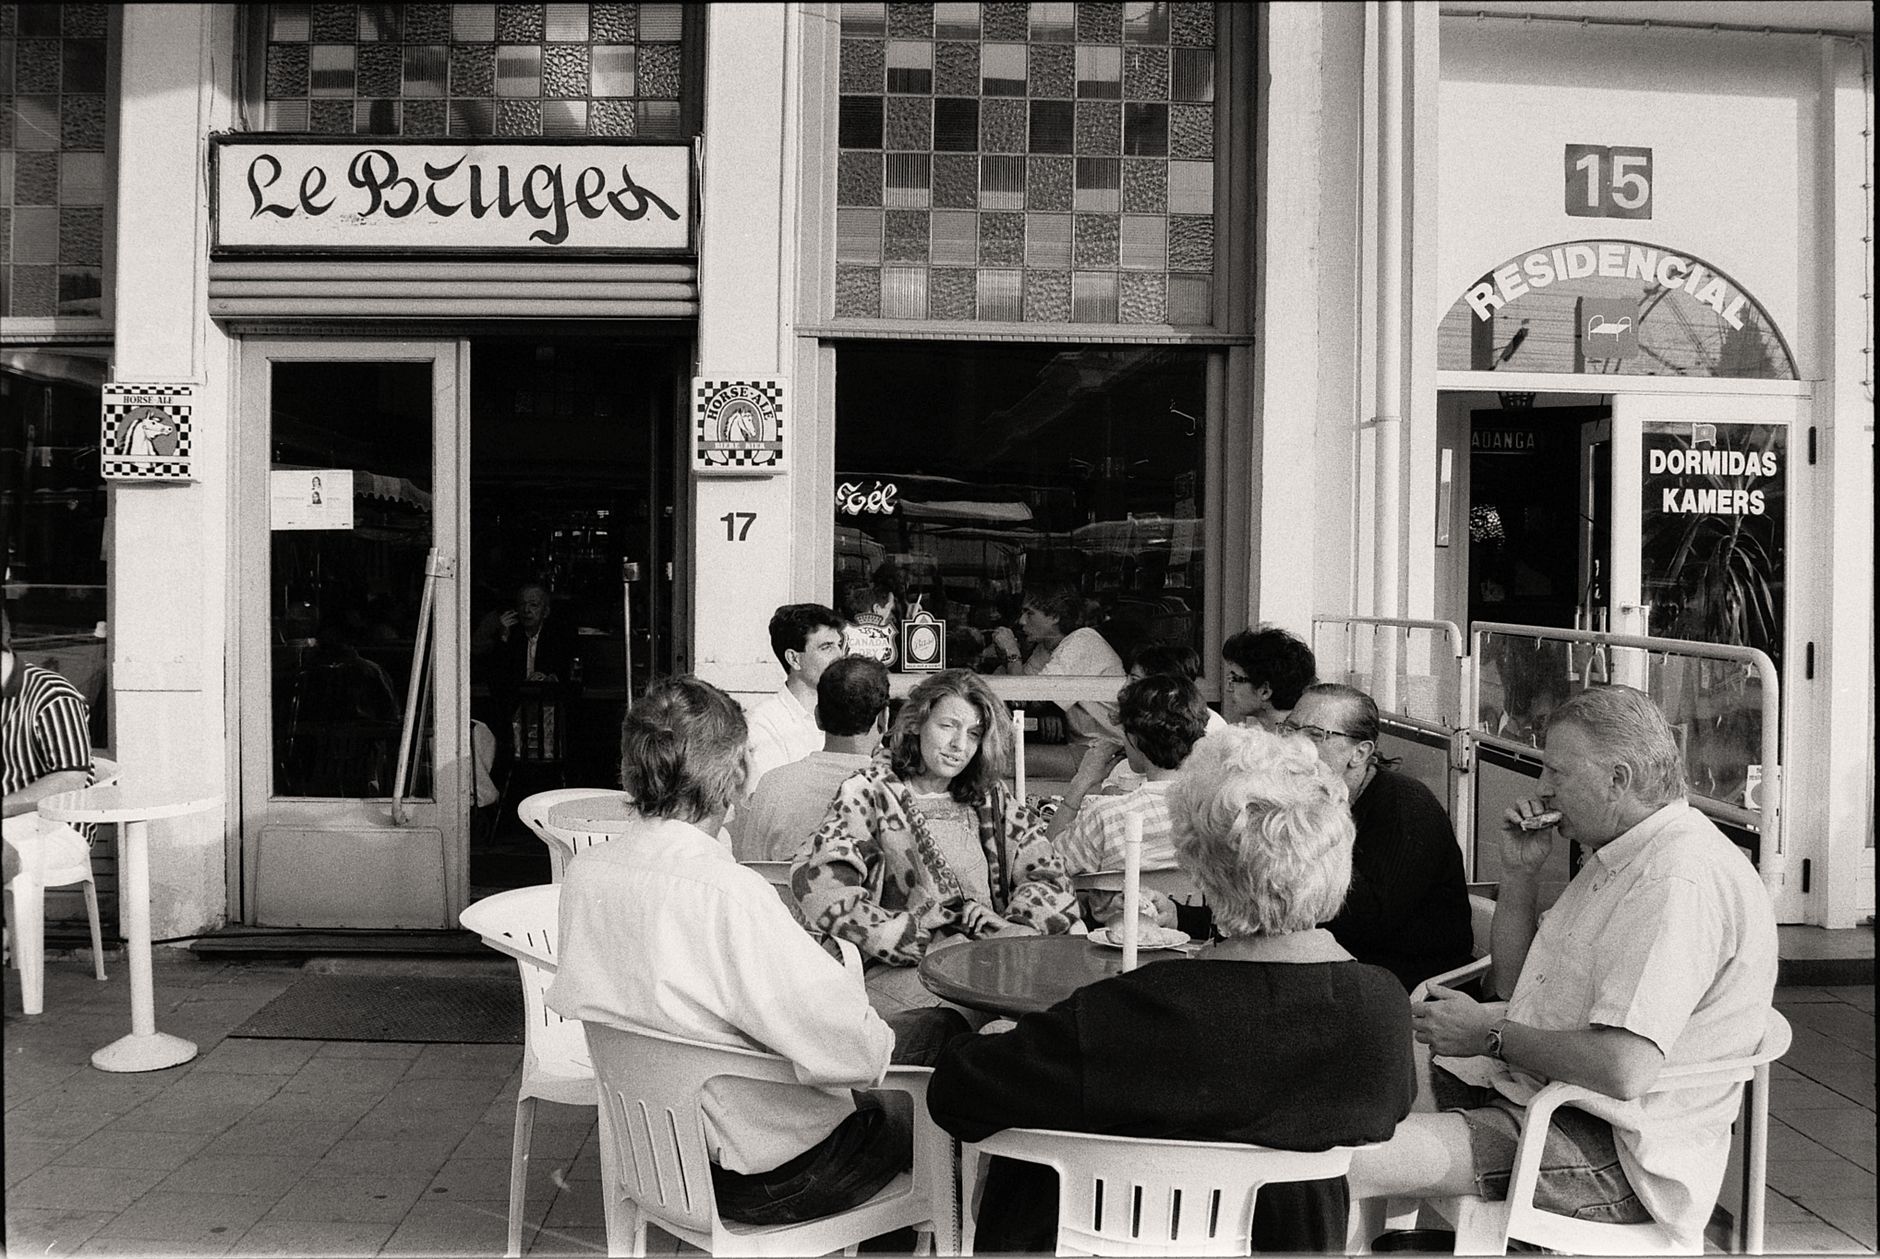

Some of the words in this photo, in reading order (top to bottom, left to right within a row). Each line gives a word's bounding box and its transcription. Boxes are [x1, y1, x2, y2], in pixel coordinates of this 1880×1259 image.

[1575, 154, 1649, 209] 15
[247, 153, 337, 220] Le
[347, 149, 681, 245] Bruges
[1464, 245, 1746, 331] RESIDENCIAL
[123, 395, 153, 404] HORSE
[157, 396, 174, 404] ALE
[1650, 449, 1777, 477] DORMIDAS
[1662, 488, 1765, 515] KAMERS
[720, 512, 757, 541] 17
[848, 638, 888, 647] CANADA
